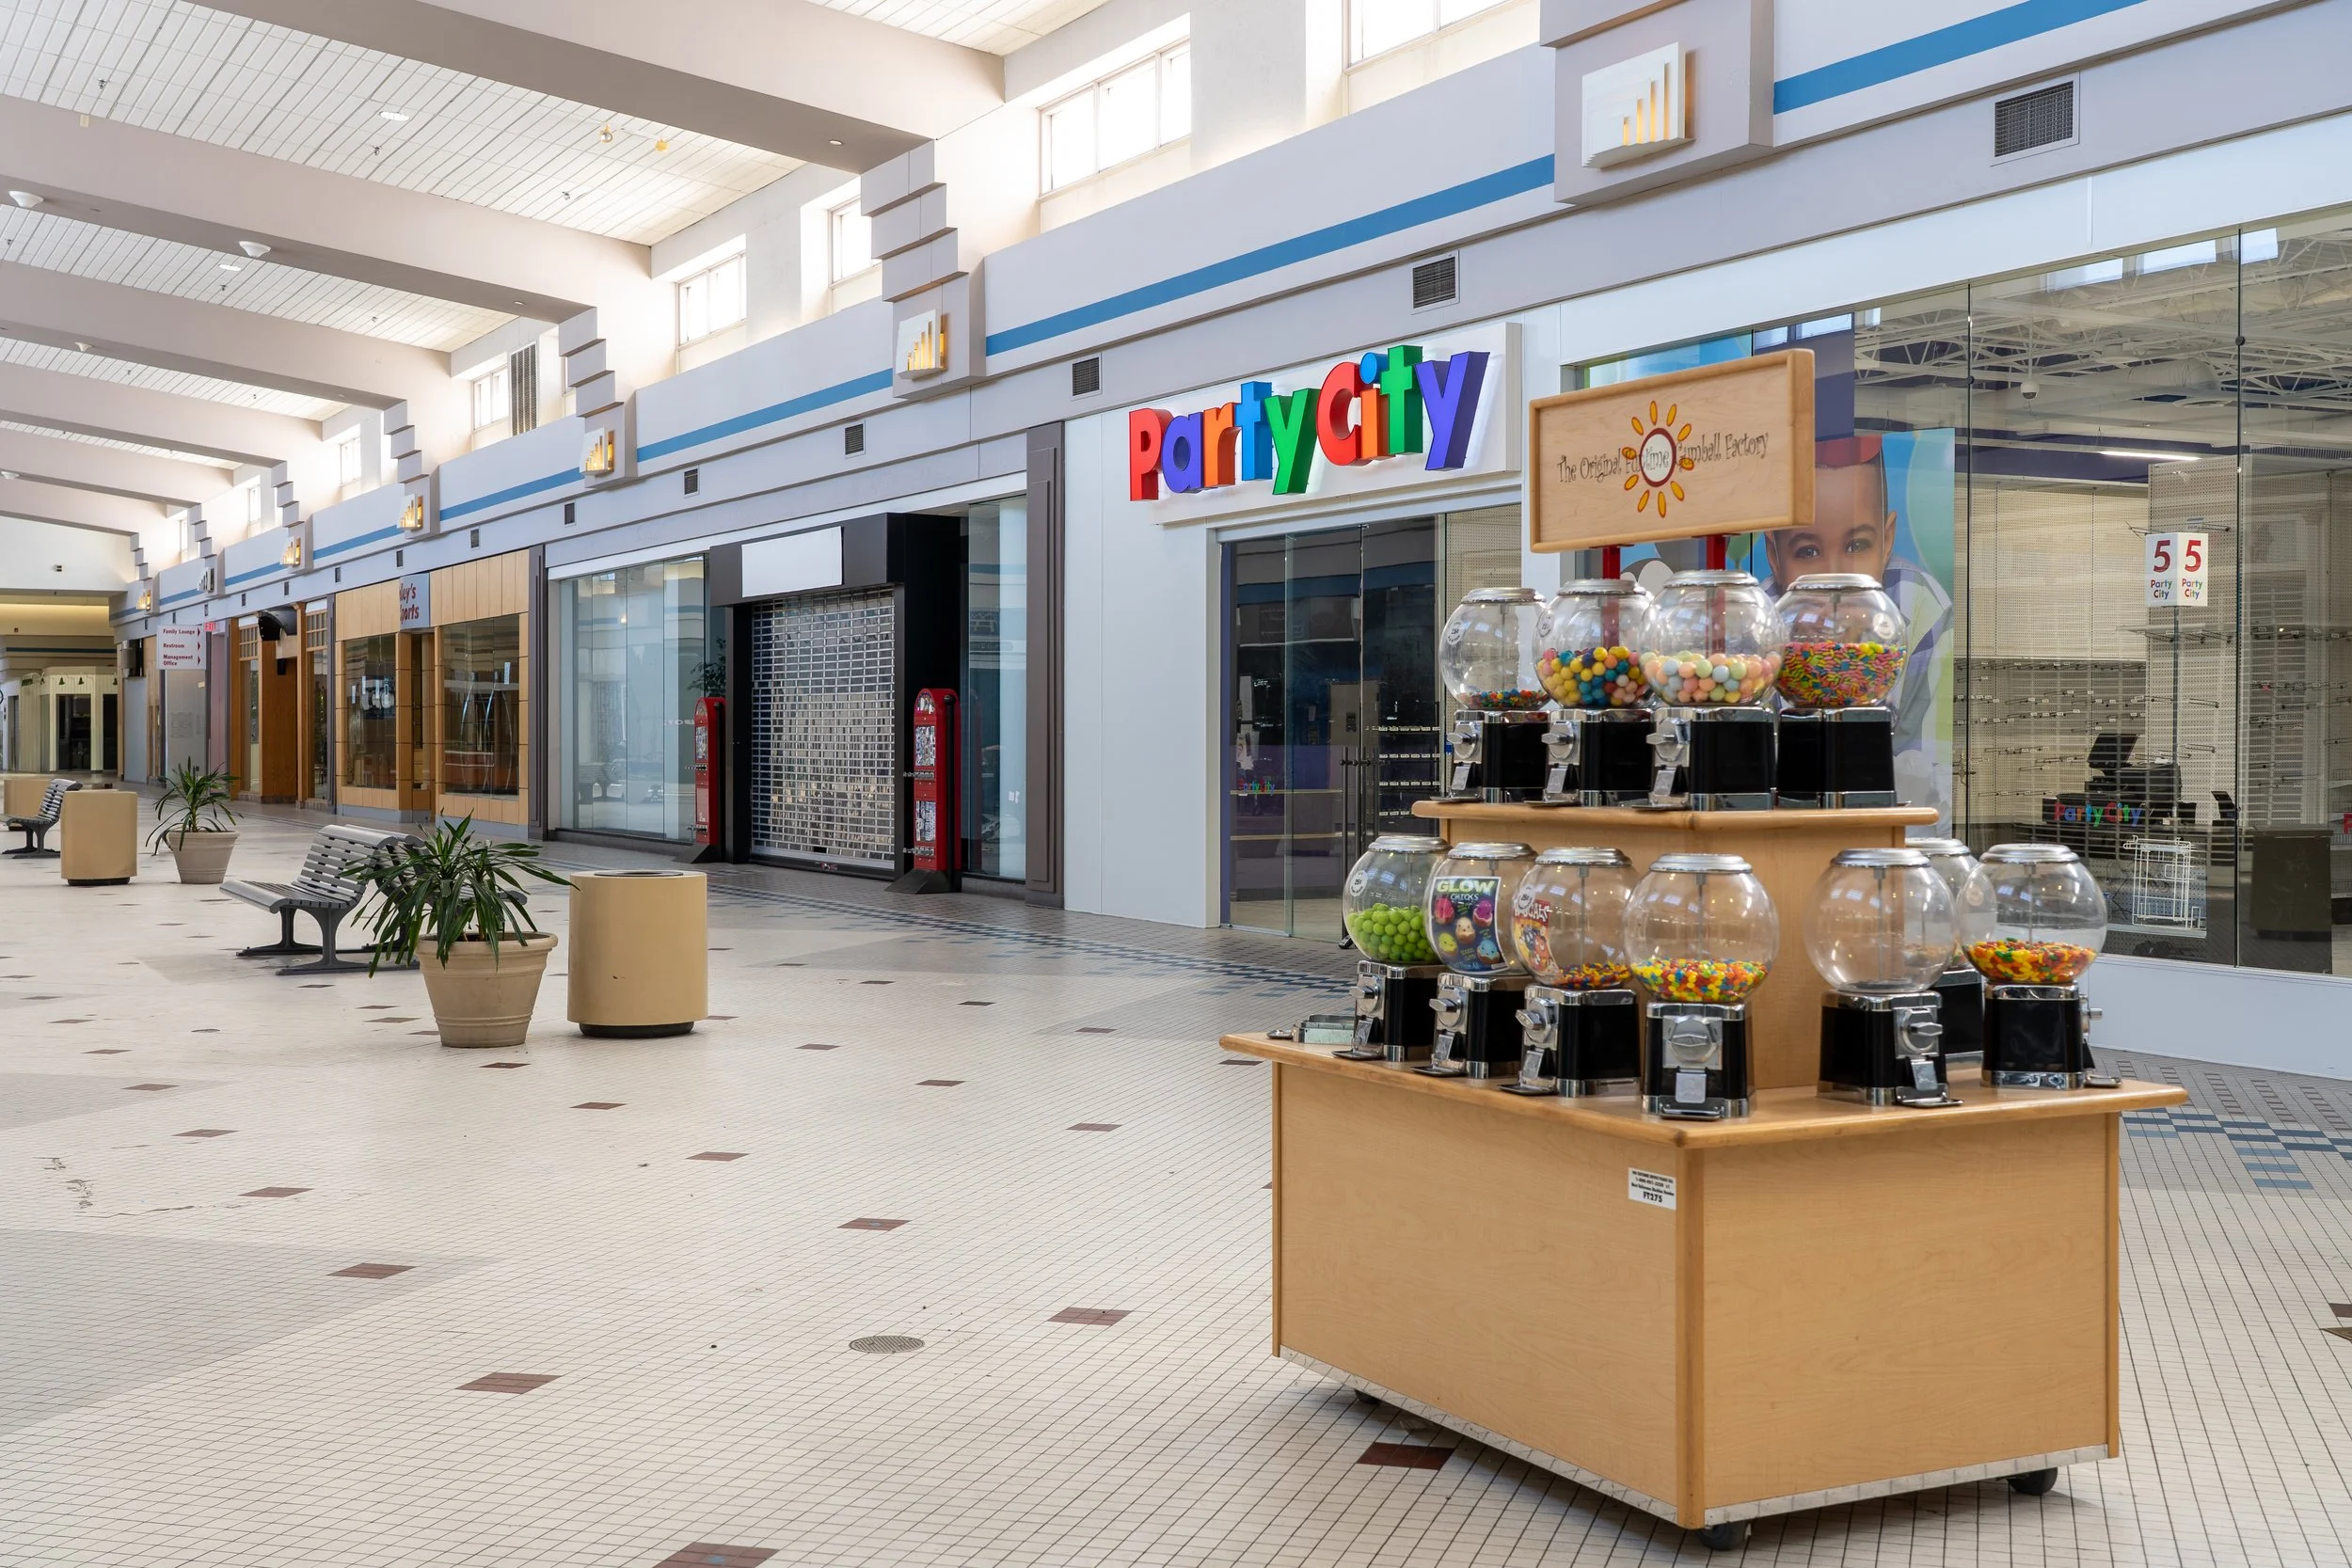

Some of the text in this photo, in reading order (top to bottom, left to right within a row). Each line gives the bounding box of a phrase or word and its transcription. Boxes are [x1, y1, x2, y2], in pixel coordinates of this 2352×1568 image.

[1557, 454, 1577, 483] The
[1580, 448, 1622, 483] Original
[1724, 432, 1770, 459] Factory
[2153, 539, 2170, 573] 5
[2185, 539, 2201, 573] 5
[2150, 579, 2172, 590] Party
[2182, 578, 2202, 590] Party
[2153, 589, 2169, 599] City
[2185, 589, 2201, 599] City
[1437, 879, 1495, 893] GLOW
[1450, 893, 1479, 901] CHICKS
[1643, 1191, 1662, 1203] FT275
